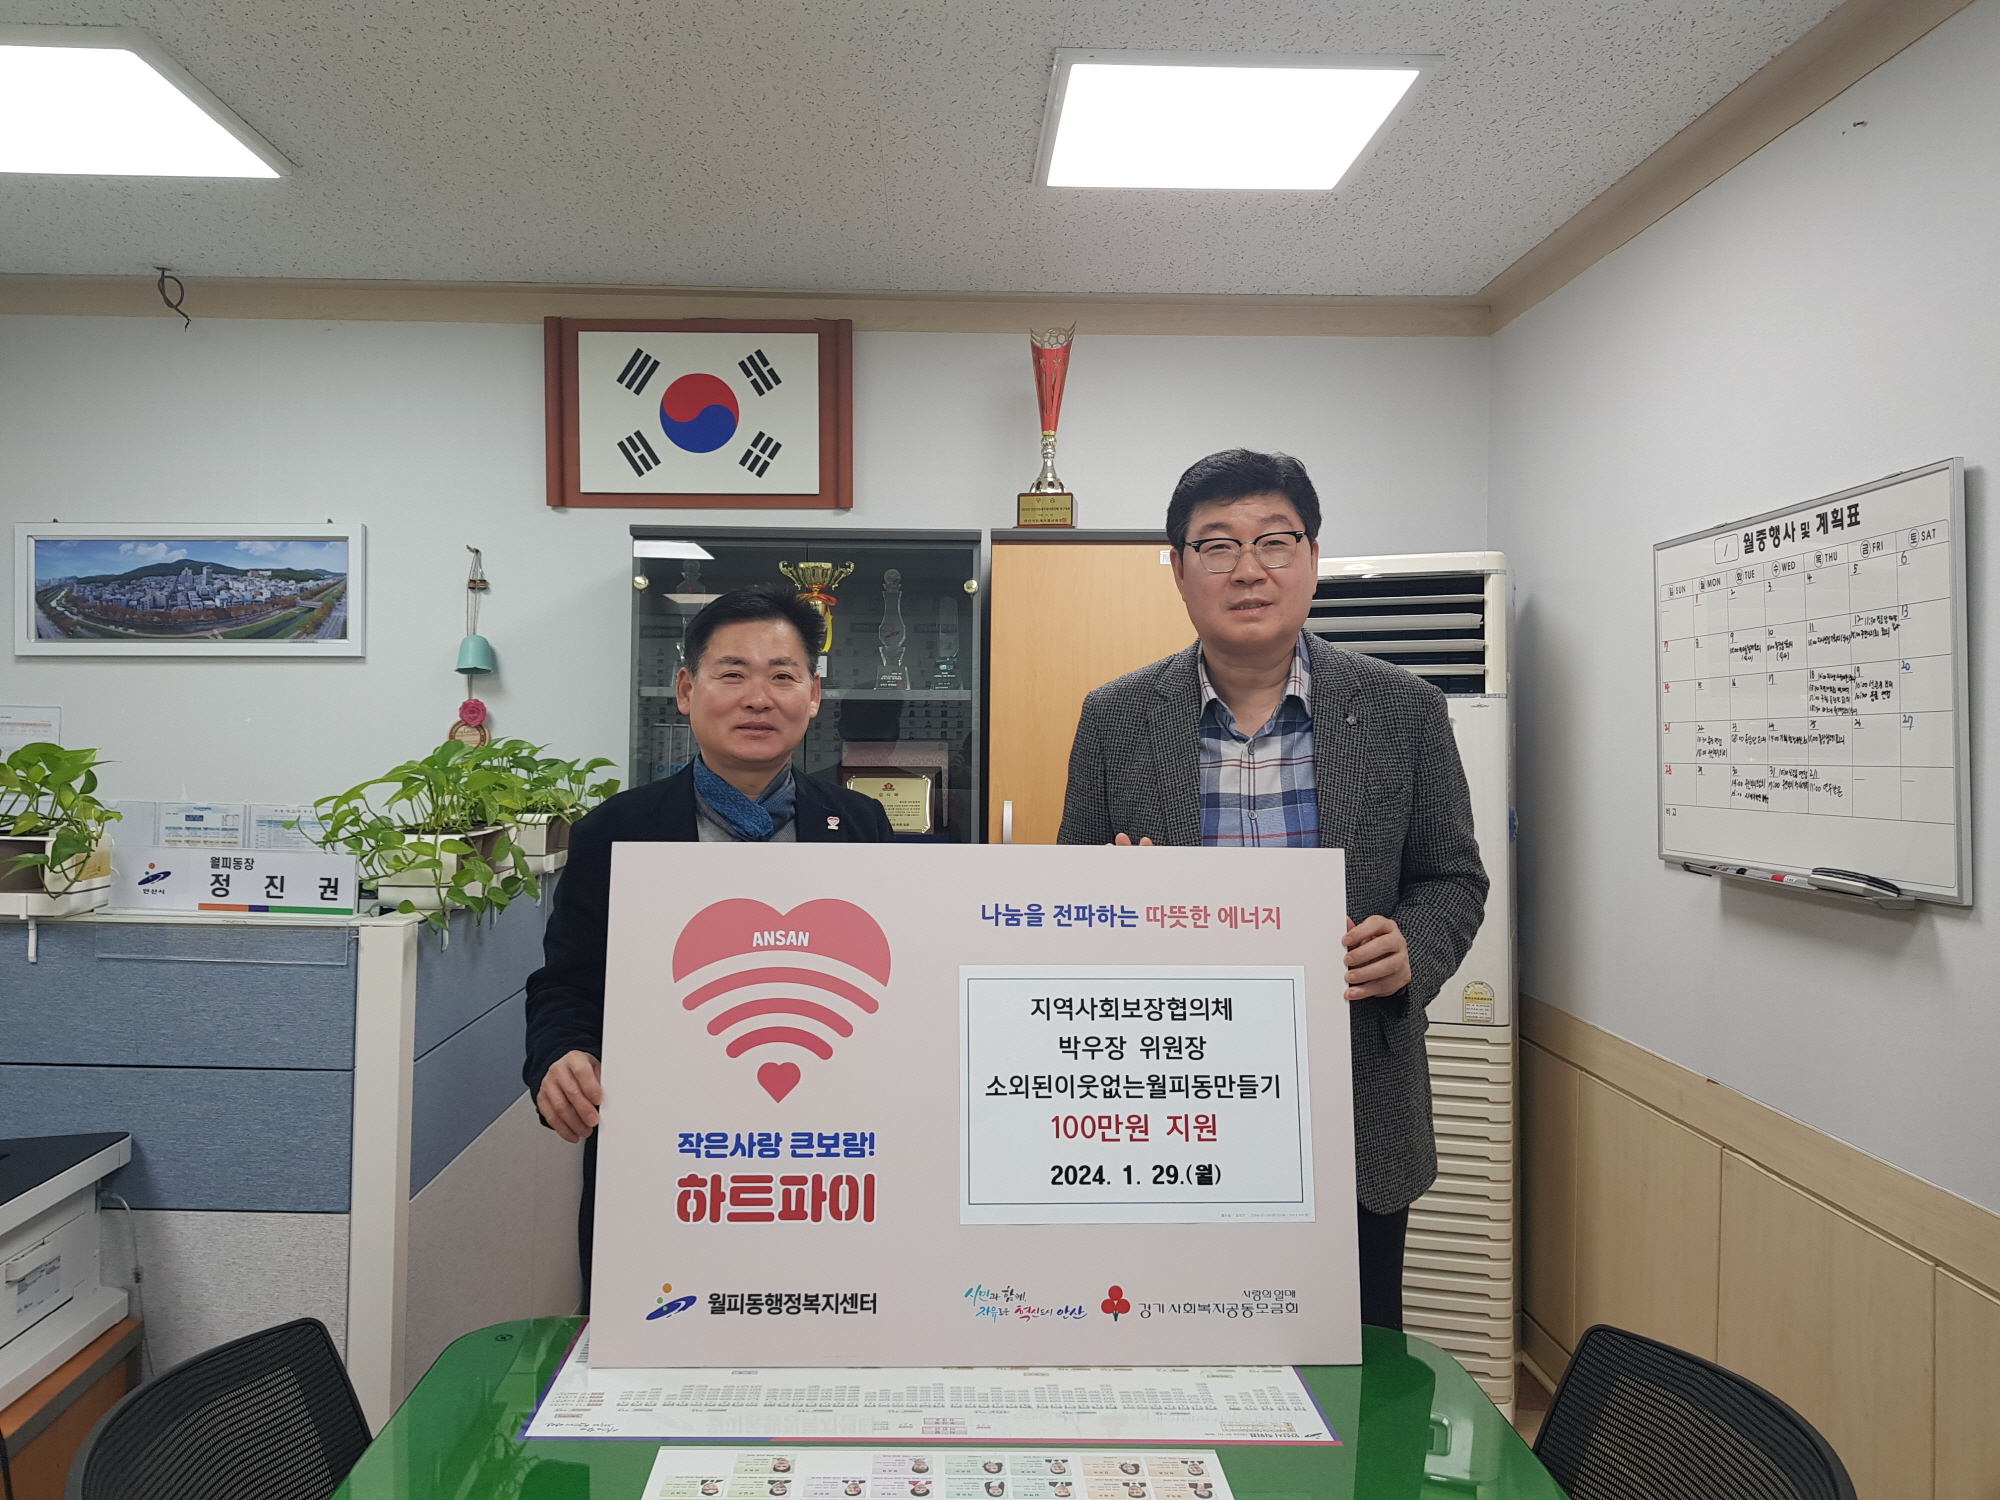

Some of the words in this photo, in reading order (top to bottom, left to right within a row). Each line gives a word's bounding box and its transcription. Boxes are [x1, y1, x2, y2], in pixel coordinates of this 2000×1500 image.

[1743, 521, 1796, 554] 월중행사
[1801, 521, 1810, 539] 및
[1816, 503, 1861, 534] 계획표
[1909, 530, 1919, 546] 토
[1921, 528, 1937, 543] SAT
[1861, 542, 1871, 557] 금
[1872, 541, 1885, 554] FRI
[1814, 552, 1823, 566] 목
[1824, 550, 1839, 564] THU
[1900, 550, 1909, 566] 6
[1772, 562, 1780, 575] 수
[1781, 560, 1797, 573] WED
[1852, 562, 1860, 575] 5
[1744, 569, 1756, 581] TUE
[1806, 571, 1813, 584] 4
[1707, 577, 1722, 588] MON
[1767, 580, 1774, 593] 3
[1675, 585, 1687, 595] SUN
[1730, 588, 1737, 597] 2
[1901, 604, 1910, 618] 13
[1854, 614, 1863, 626] 12
[1767, 628, 1775, 637] 10
[1809, 622, 1816, 633] 11
[1730, 632, 1736, 644] 9
[1664, 641, 1670, 653] 7
[1854, 666, 1861, 678] 19
[1901, 660, 1911, 672] 20
[1768, 673, 1775, 685] 17
[1809, 670, 1815, 680] 18
[1731, 678, 1737, 687] 16
[1810, 719, 1817, 728] 25
[1902, 714, 1914, 731] 27
[1665, 765, 1672, 775] 28
[1697, 765, 1703, 775] 29
[1732, 766, 1738, 775] 30
[1769, 766, 1776, 777] 31
[209, 856, 255, 870] 월피동장
[982, 904, 1045, 927] 나눔을
[1053, 904, 1138, 927] 전파하는
[1146, 905, 1210, 928] 따뜻한
[1218, 906, 1280, 930] 에너지
[752, 930, 810, 947] ANSAN
[1031, 997, 1232, 1021] 지역사회보장협의체
[1060, 1036, 1126, 1060] 박우장
[1140, 1036, 1206, 1060] 위원장
[986, 1075, 1279, 1099] 소외된이웃없는월피동만들기
[1052, 1114, 1149, 1142] 100만원
[1166, 1114, 1217, 1142] 지원
[678, 1132, 782, 1158] 작은사랑
[790, 1132, 874, 1158] 큰보람!
[1051, 1165, 1110, 1185] 2024.
[1123, 1165, 1140, 1184] 1.
[1152, 1164, 1221, 1185] 29.(월)
[677, 1174, 875, 1223] 하트파이
[964, 1284, 1001, 1308] 시민과
[708, 1293, 876, 1315] 월피동행정복지센터
[1136, 1302, 1166, 1320] 경기
[1167, 1301, 1300, 1319] 사회복지공동모금회
[1014, 1305, 1053, 1322] 혁신도시
[1056, 1305, 1089, 1320] 안산
